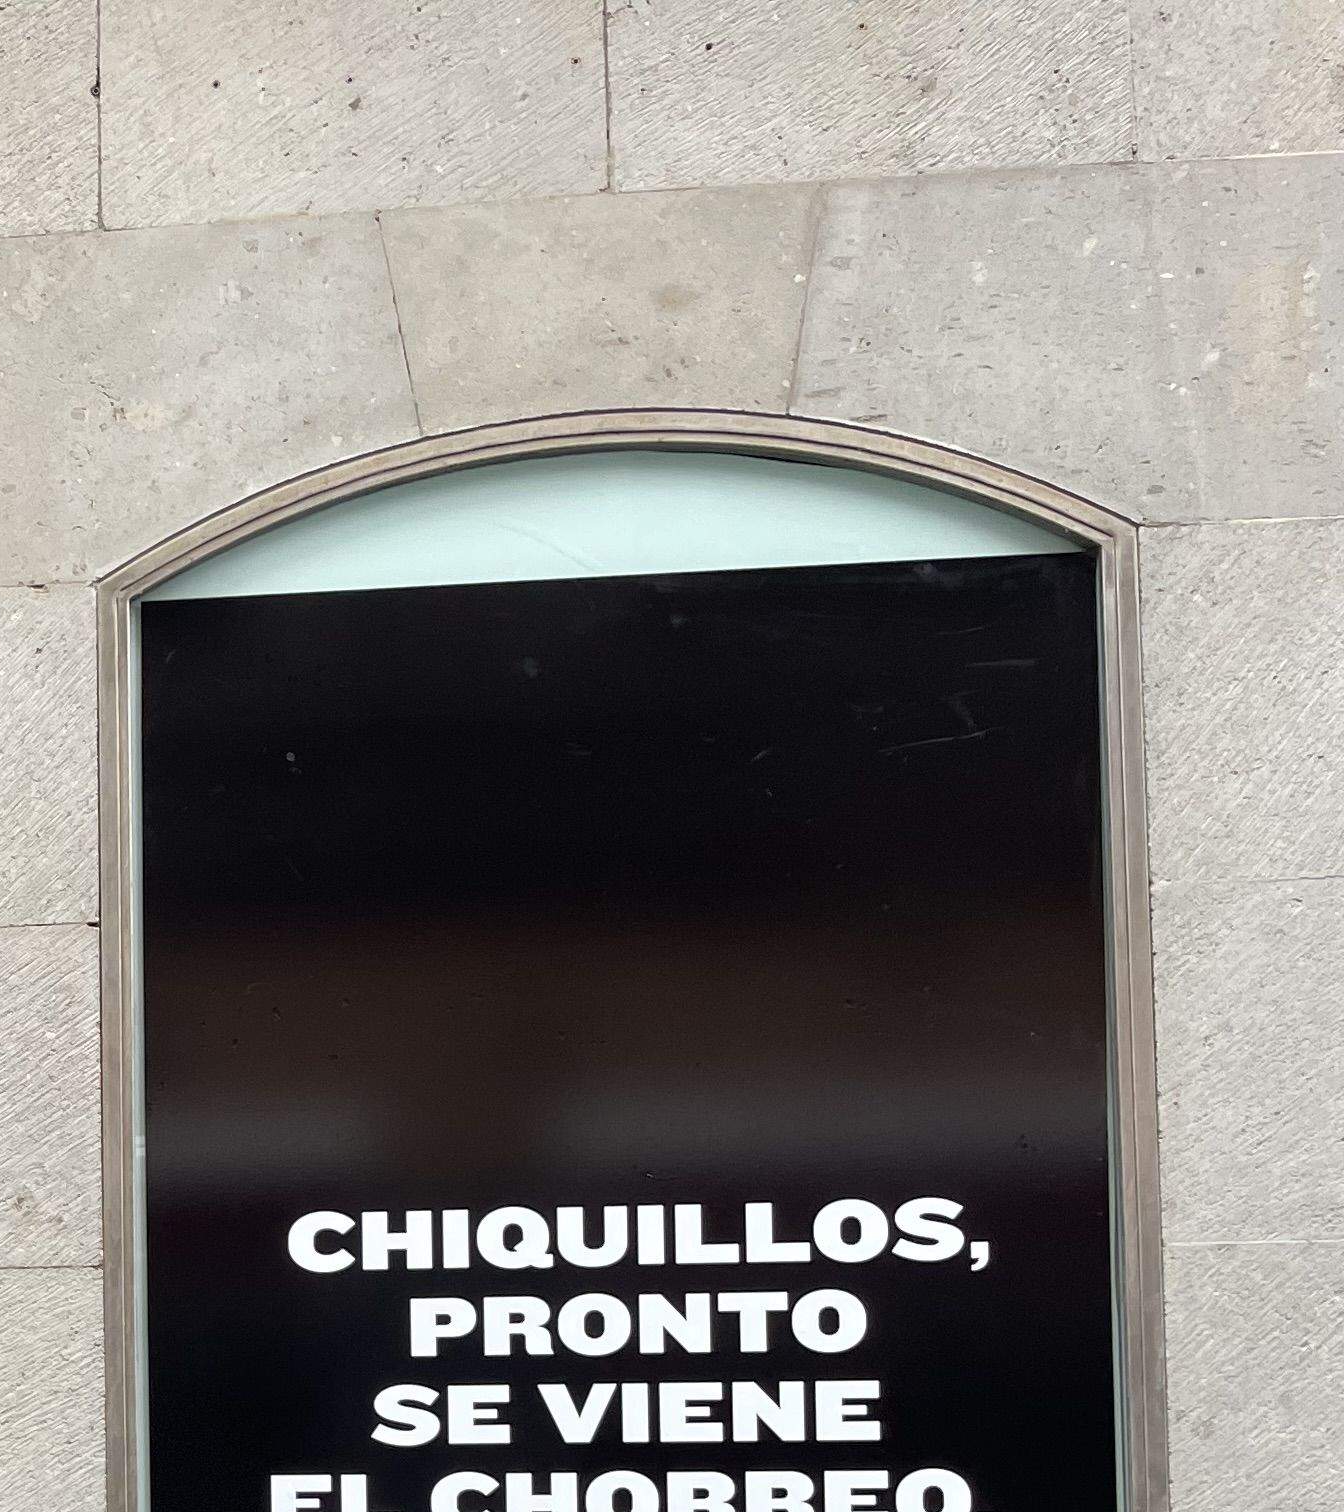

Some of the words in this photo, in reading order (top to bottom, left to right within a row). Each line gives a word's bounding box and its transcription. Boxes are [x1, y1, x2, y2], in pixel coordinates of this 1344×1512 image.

[287, 1197, 991, 1274] CHIQUILLOS,
[410, 1289, 869, 1358] PRONTO
[371, 1384, 512, 1447] SE
[537, 1379, 882, 1445] VIENE
